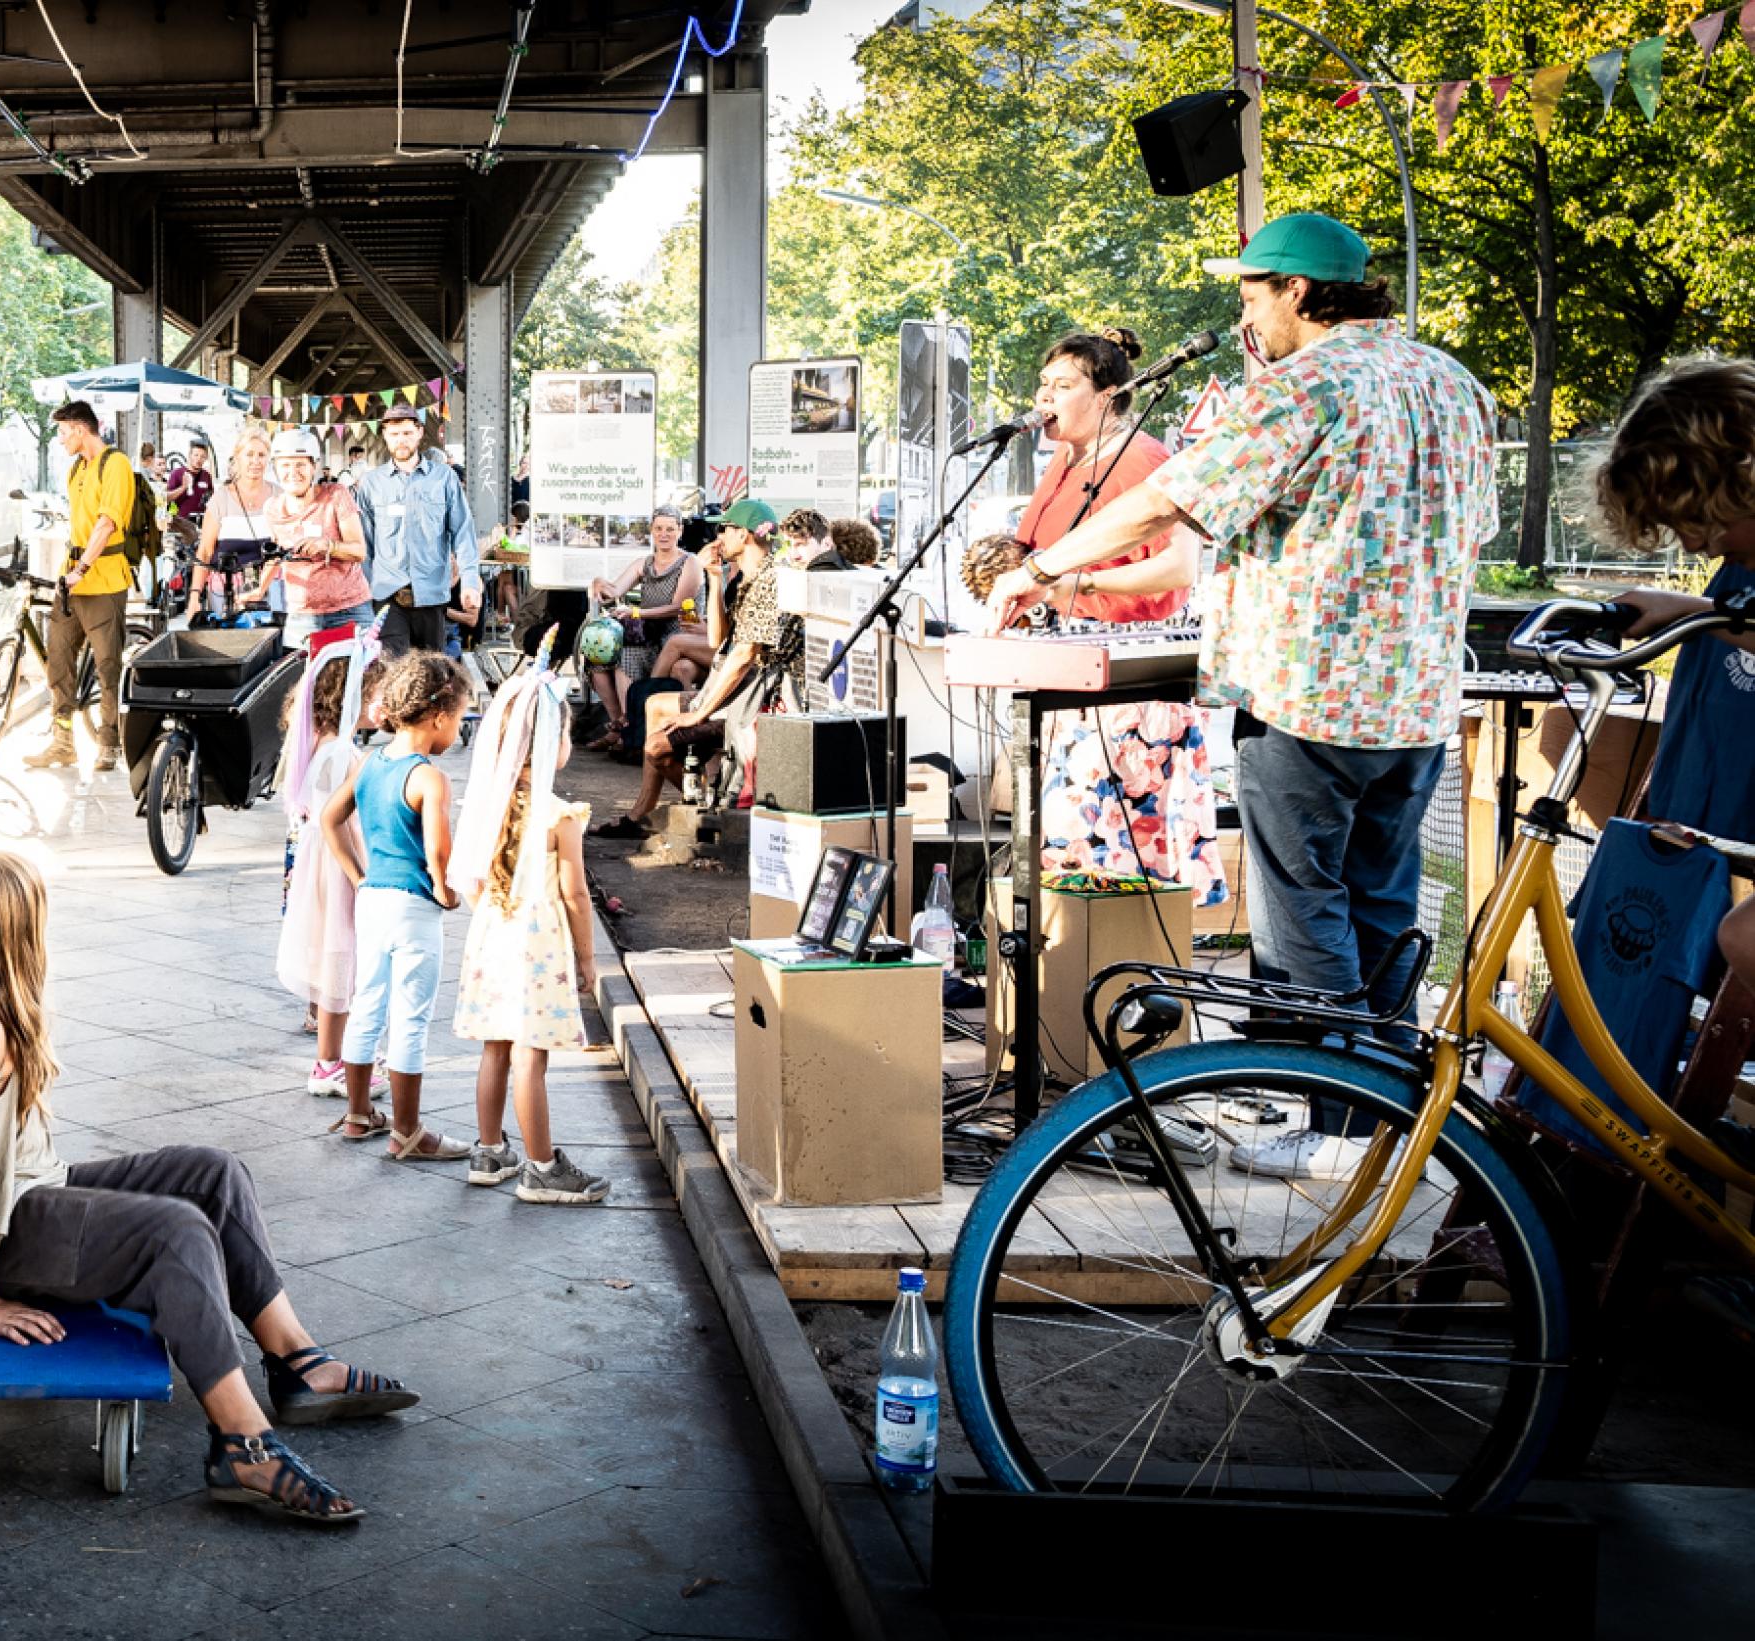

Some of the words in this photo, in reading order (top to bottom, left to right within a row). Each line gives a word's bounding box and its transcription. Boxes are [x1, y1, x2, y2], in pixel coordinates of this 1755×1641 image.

[548, 463, 569, 475] Wie
[571, 463, 618, 478] gestalten
[620, 464, 637, 475] wir
[541, 479, 595, 488] zusammen
[597, 476, 613, 489] die
[615, 476, 644, 489] Stadt
[579, 489, 625, 506] morgen?
[1605, 1119, 1694, 1200] SWAPFIETS
